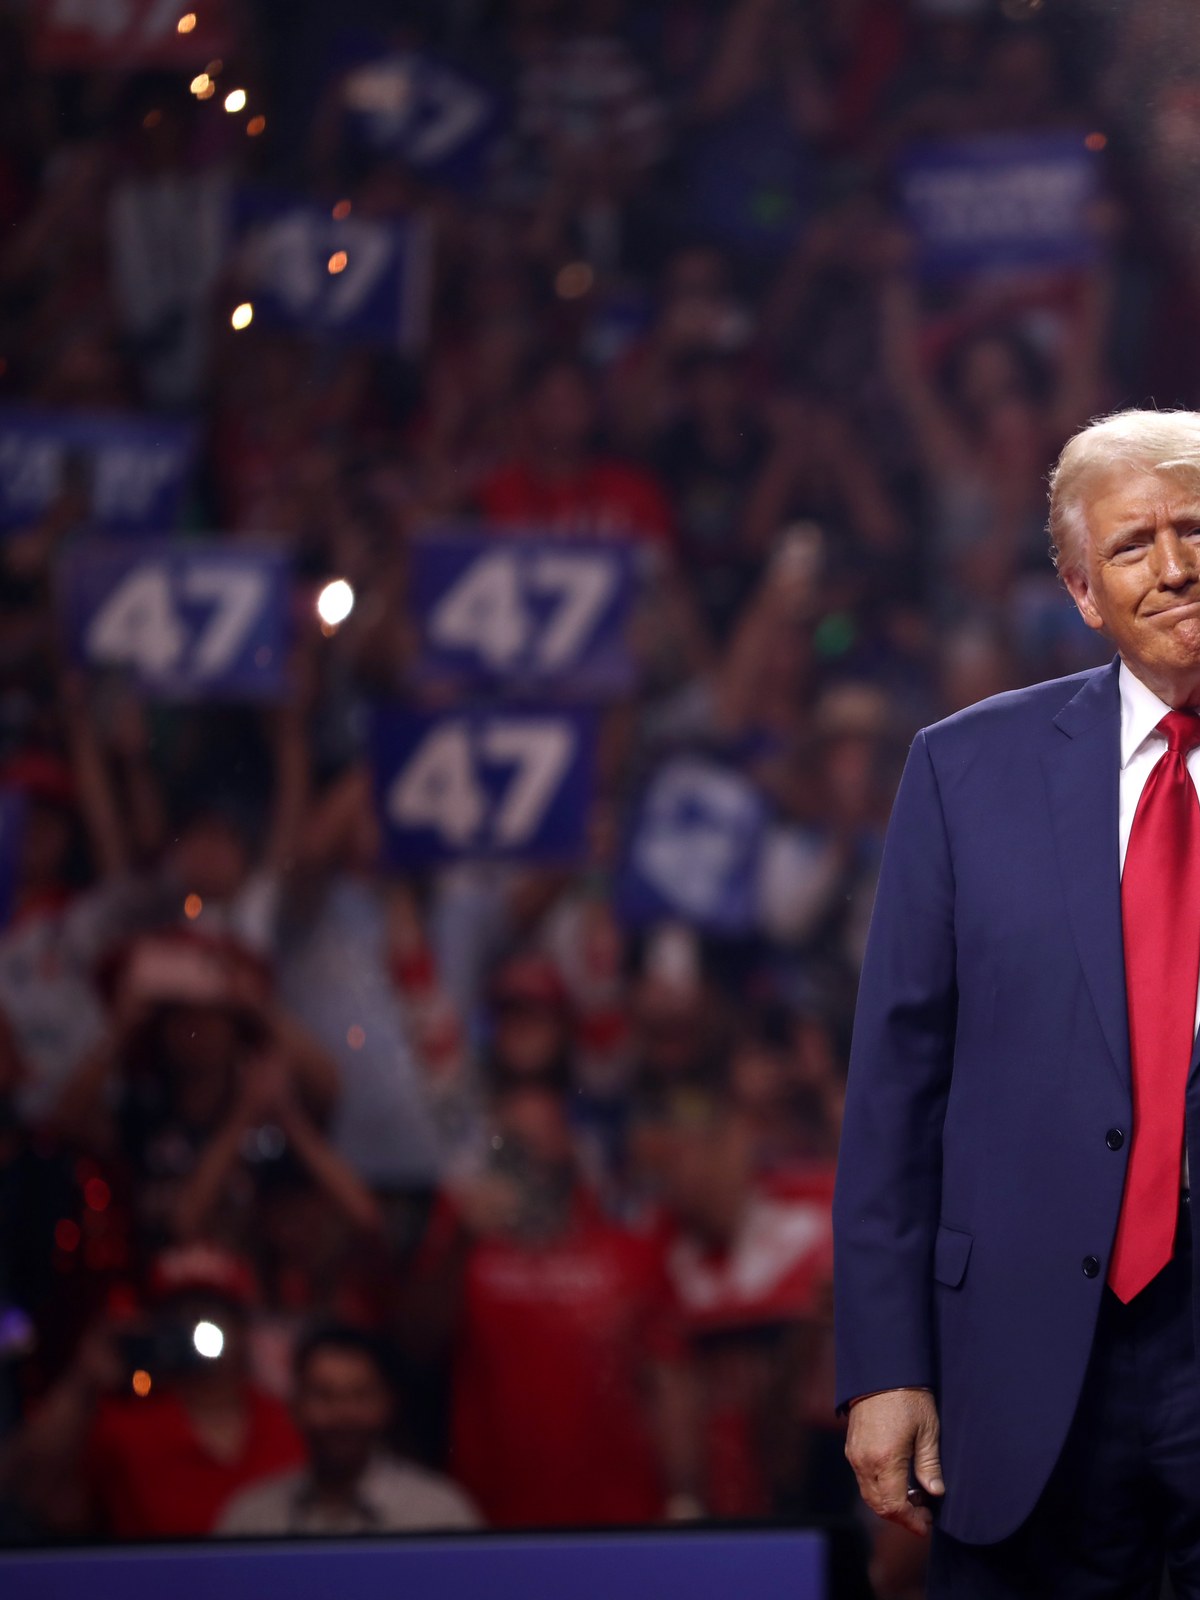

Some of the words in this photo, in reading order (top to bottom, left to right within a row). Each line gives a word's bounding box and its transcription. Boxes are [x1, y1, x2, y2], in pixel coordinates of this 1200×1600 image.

[84, 558, 270, 681] 47
[427, 550, 623, 673] 47
[386, 714, 578, 846] 47
